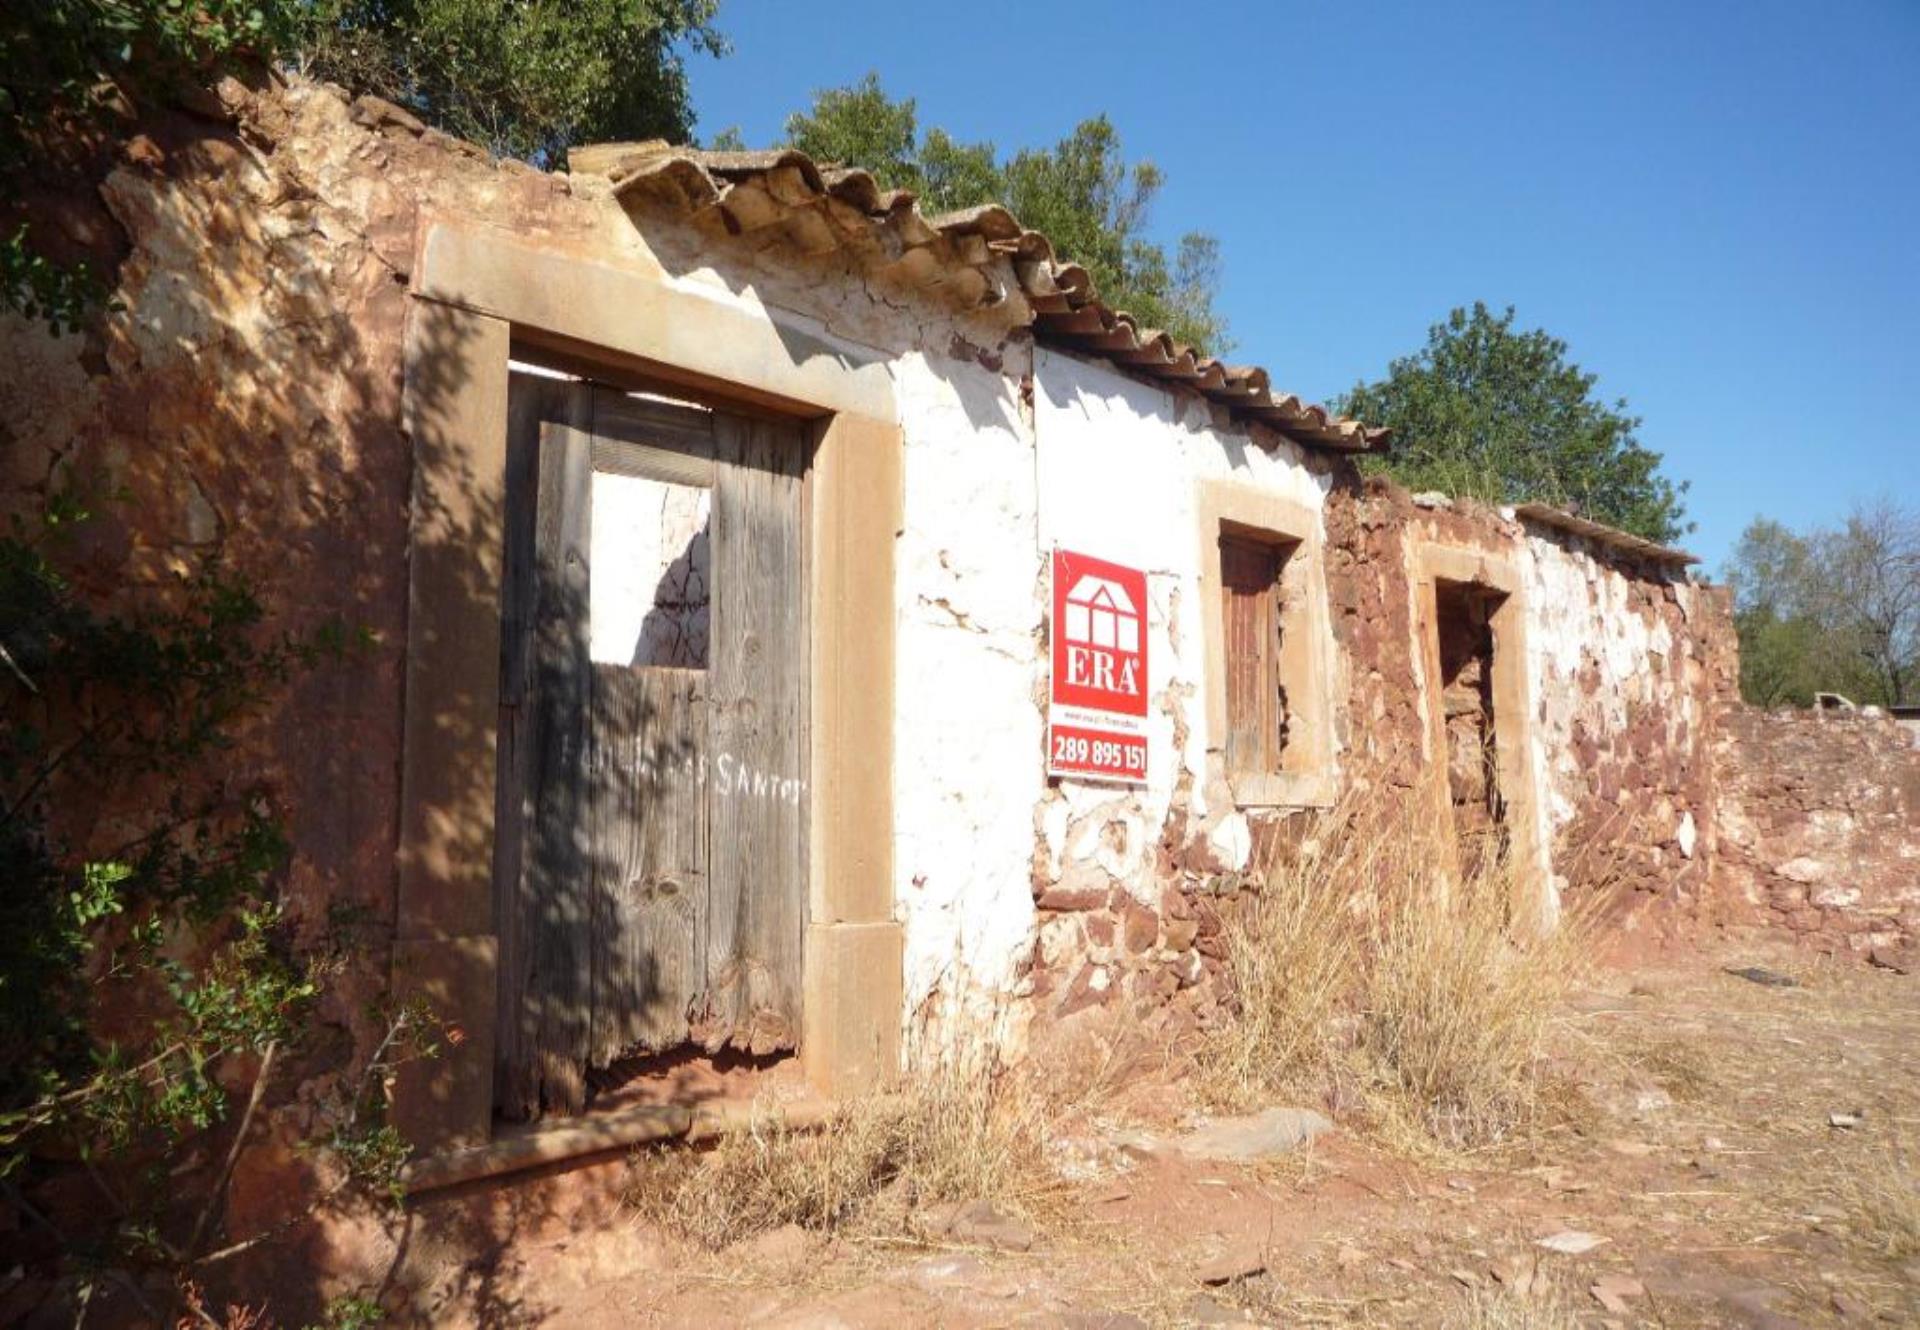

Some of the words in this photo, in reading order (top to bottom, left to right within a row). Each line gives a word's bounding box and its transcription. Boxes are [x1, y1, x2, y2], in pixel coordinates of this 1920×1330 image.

[1065, 645, 1139, 695] ERA
[1055, 735, 1088, 764] 289
[1092, 740, 1121, 768] 895
[1124, 744, 1145, 770] 151
